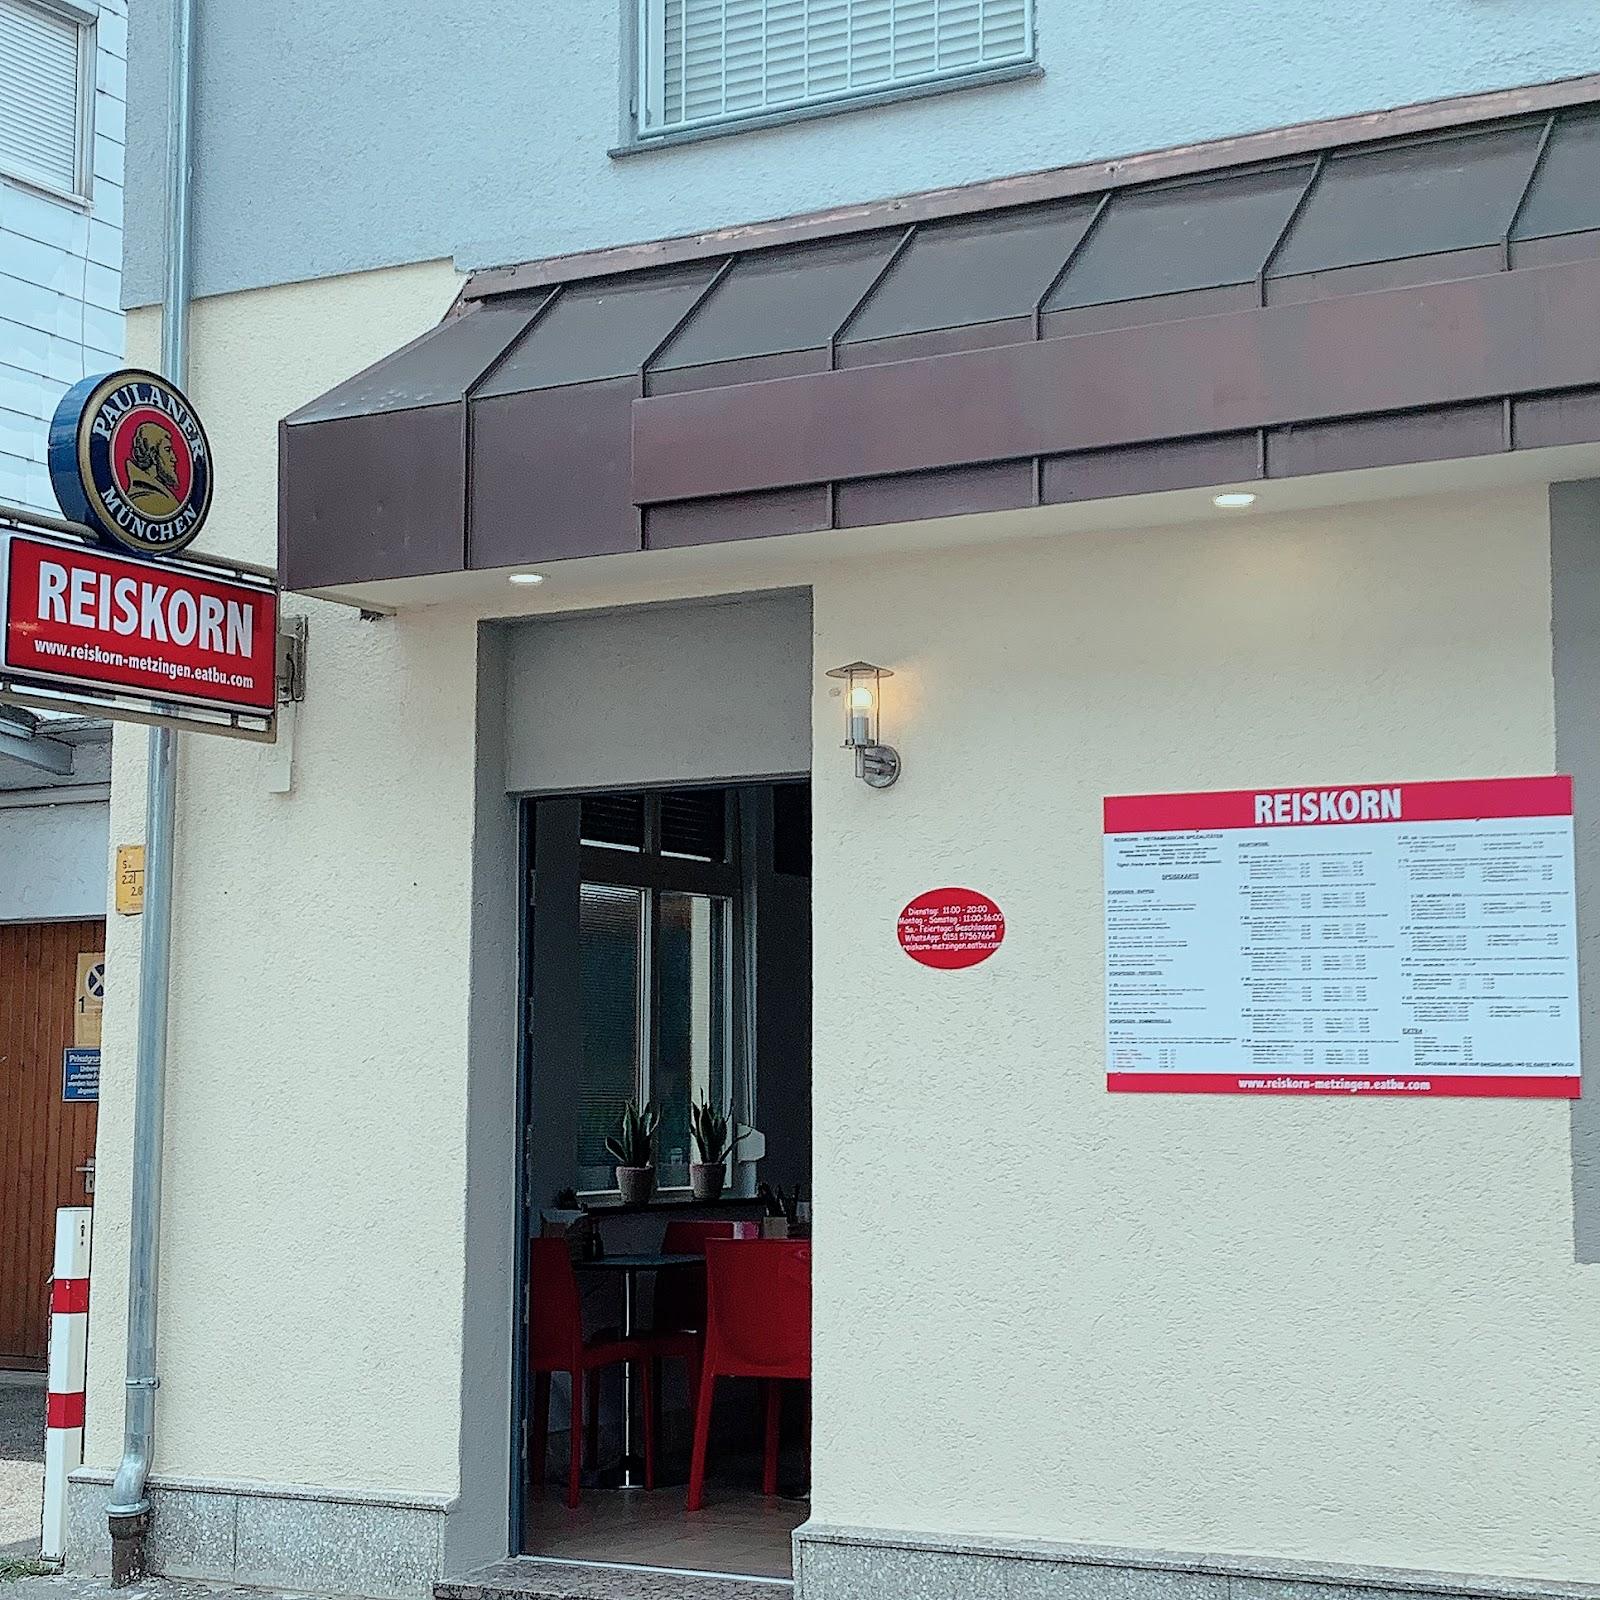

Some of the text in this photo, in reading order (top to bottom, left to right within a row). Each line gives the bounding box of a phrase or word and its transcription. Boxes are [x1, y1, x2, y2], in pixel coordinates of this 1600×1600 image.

[93, 383, 204, 462] PAULANER
[101, 485, 198, 541] MÜNCHEN
[37, 559, 253, 659] REISKORN
[34, 637, 253, 689] www.reiskorn-metzingen.eatbu.com
[1254, 788, 1402, 824] REISKORN
[929, 915, 958, 925] Samstag
[942, 905, 961, 914] 11:00
[966, 904, 988, 913] 20:00
[954, 922, 997, 932] Geschlossen
[1238, 1076, 1431, 1093] www.reiskorn-metzingen.eatbu.com
